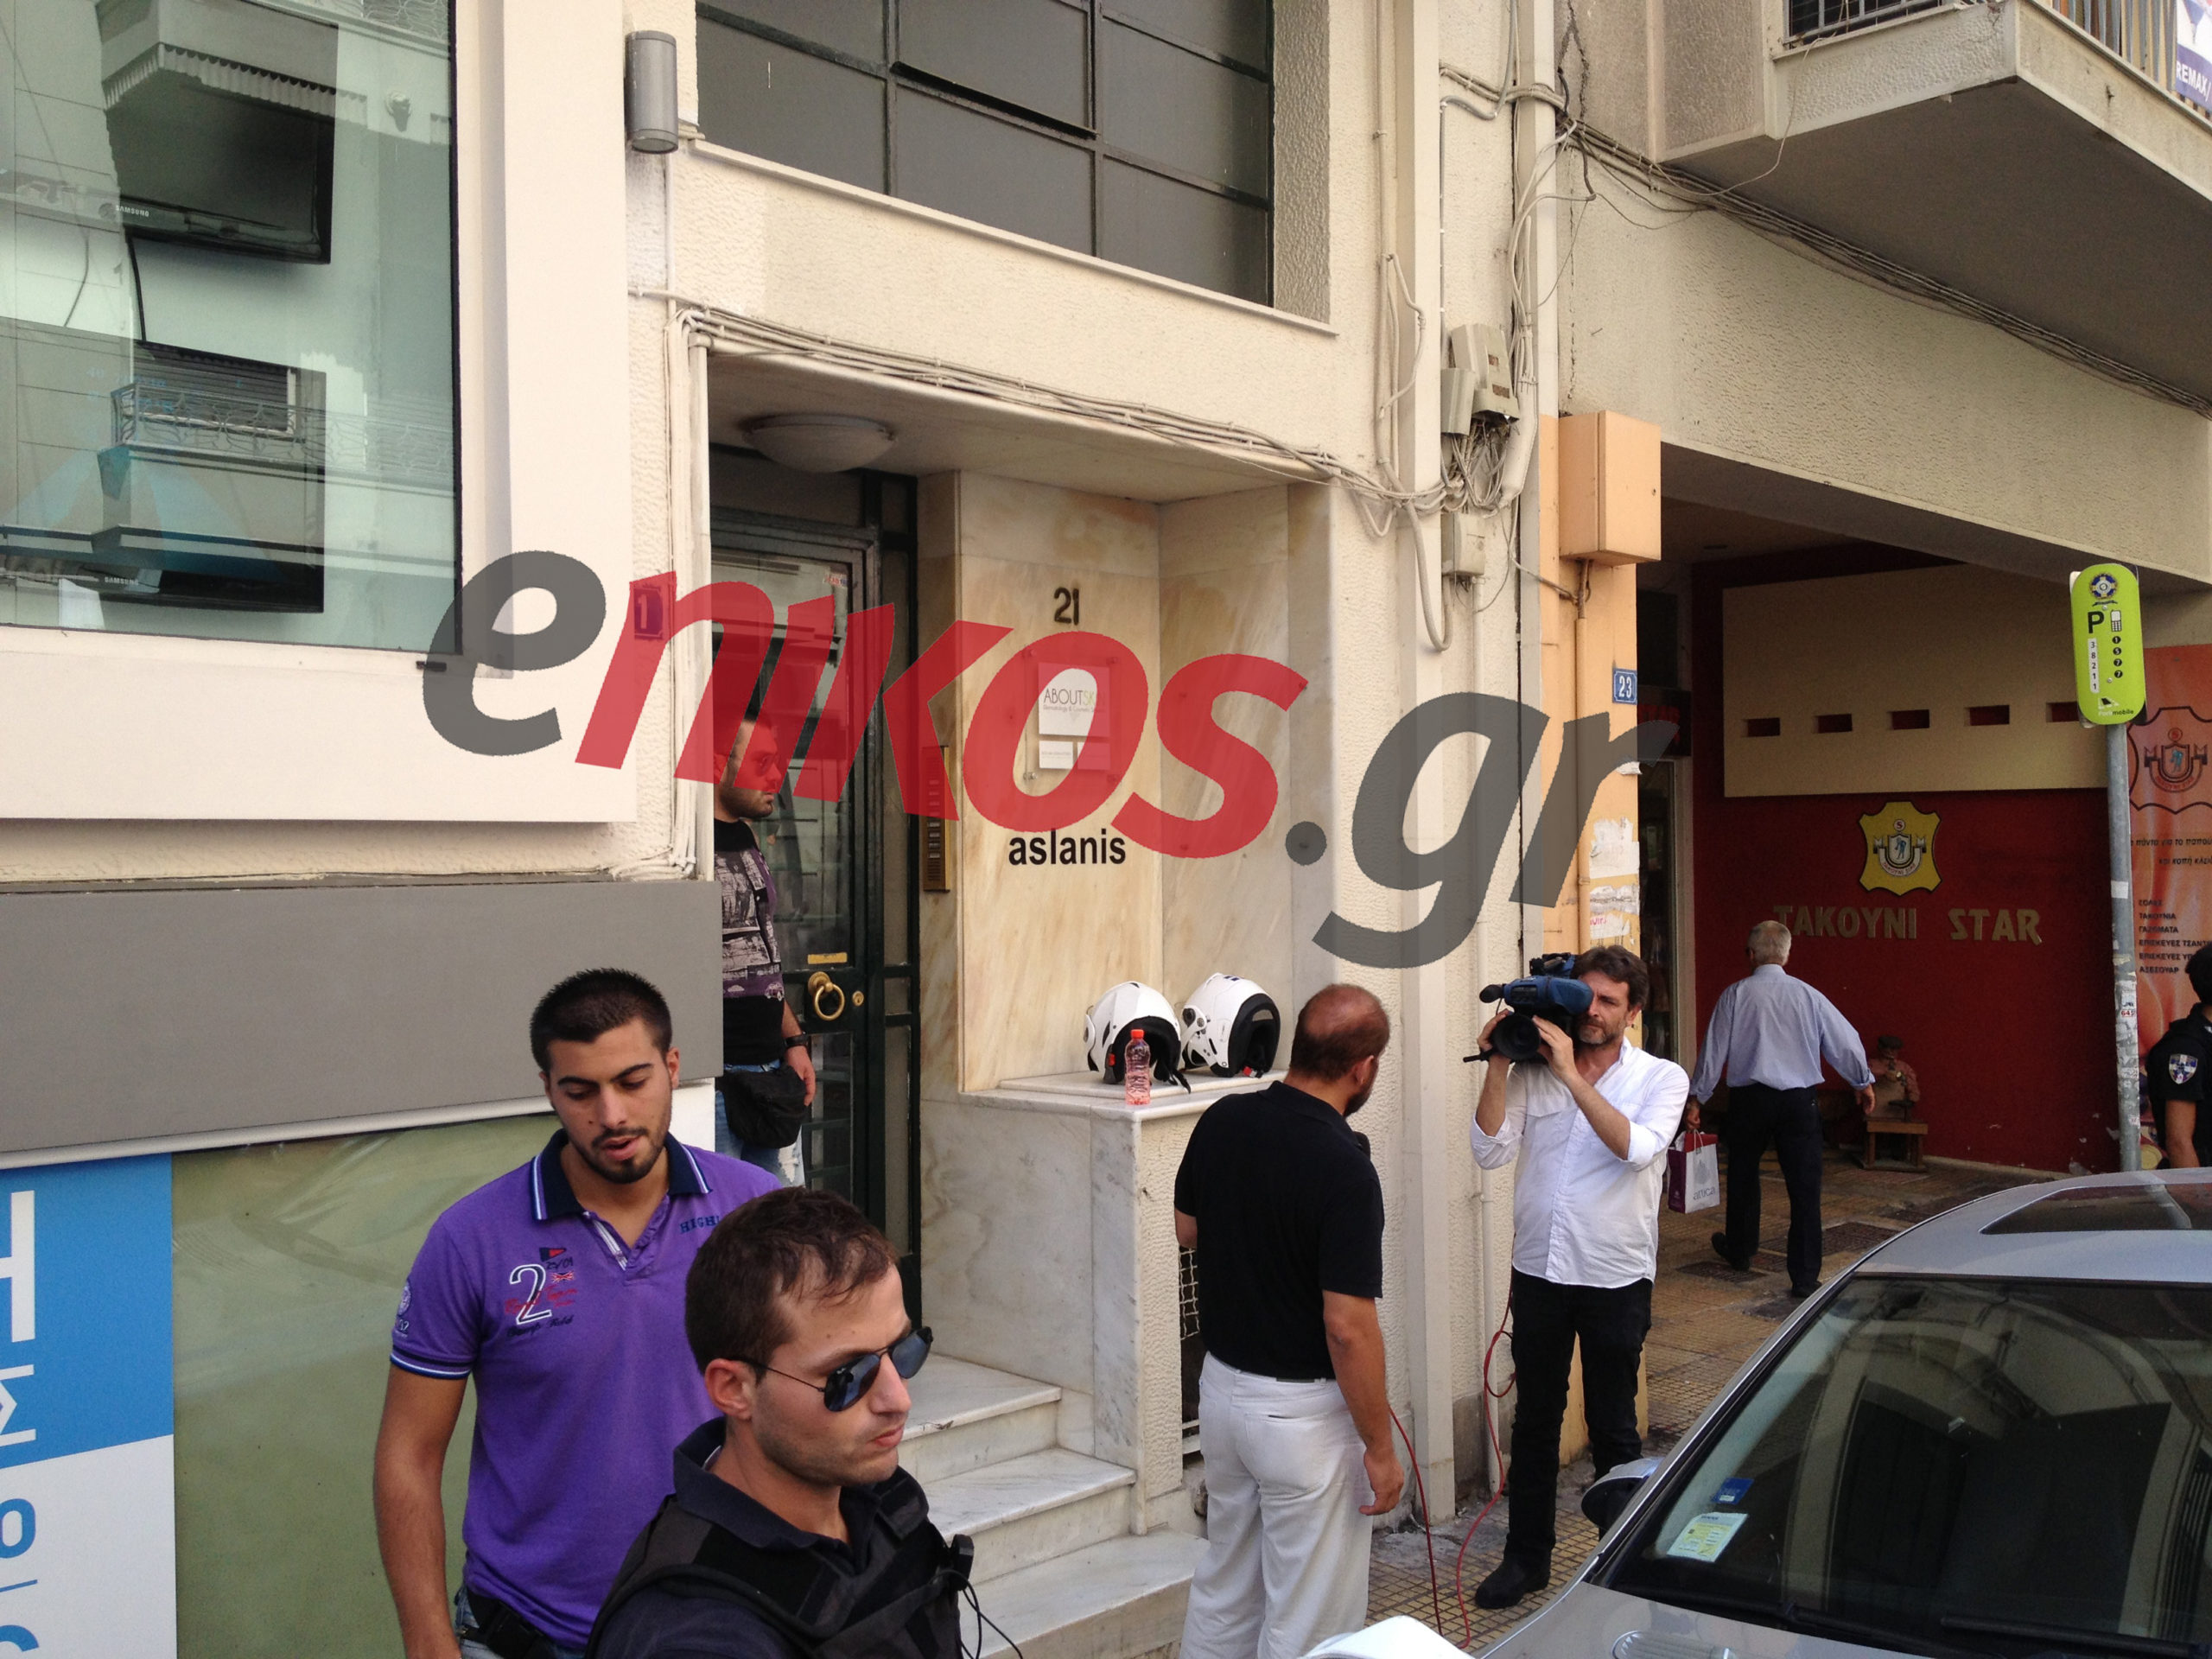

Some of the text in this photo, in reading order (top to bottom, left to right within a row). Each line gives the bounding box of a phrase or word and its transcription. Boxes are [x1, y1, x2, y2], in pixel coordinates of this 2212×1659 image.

[1053, 587, 1080, 626] 21
[2088, 611, 2104, 633] P
[1618, 675, 1632, 698] 23
[1008, 828, 1126, 865] aslanis
[1773, 906, 2042, 945] ΤΑΚΟΥΝΙ STAR
[510, 1264, 552, 1325] 2
